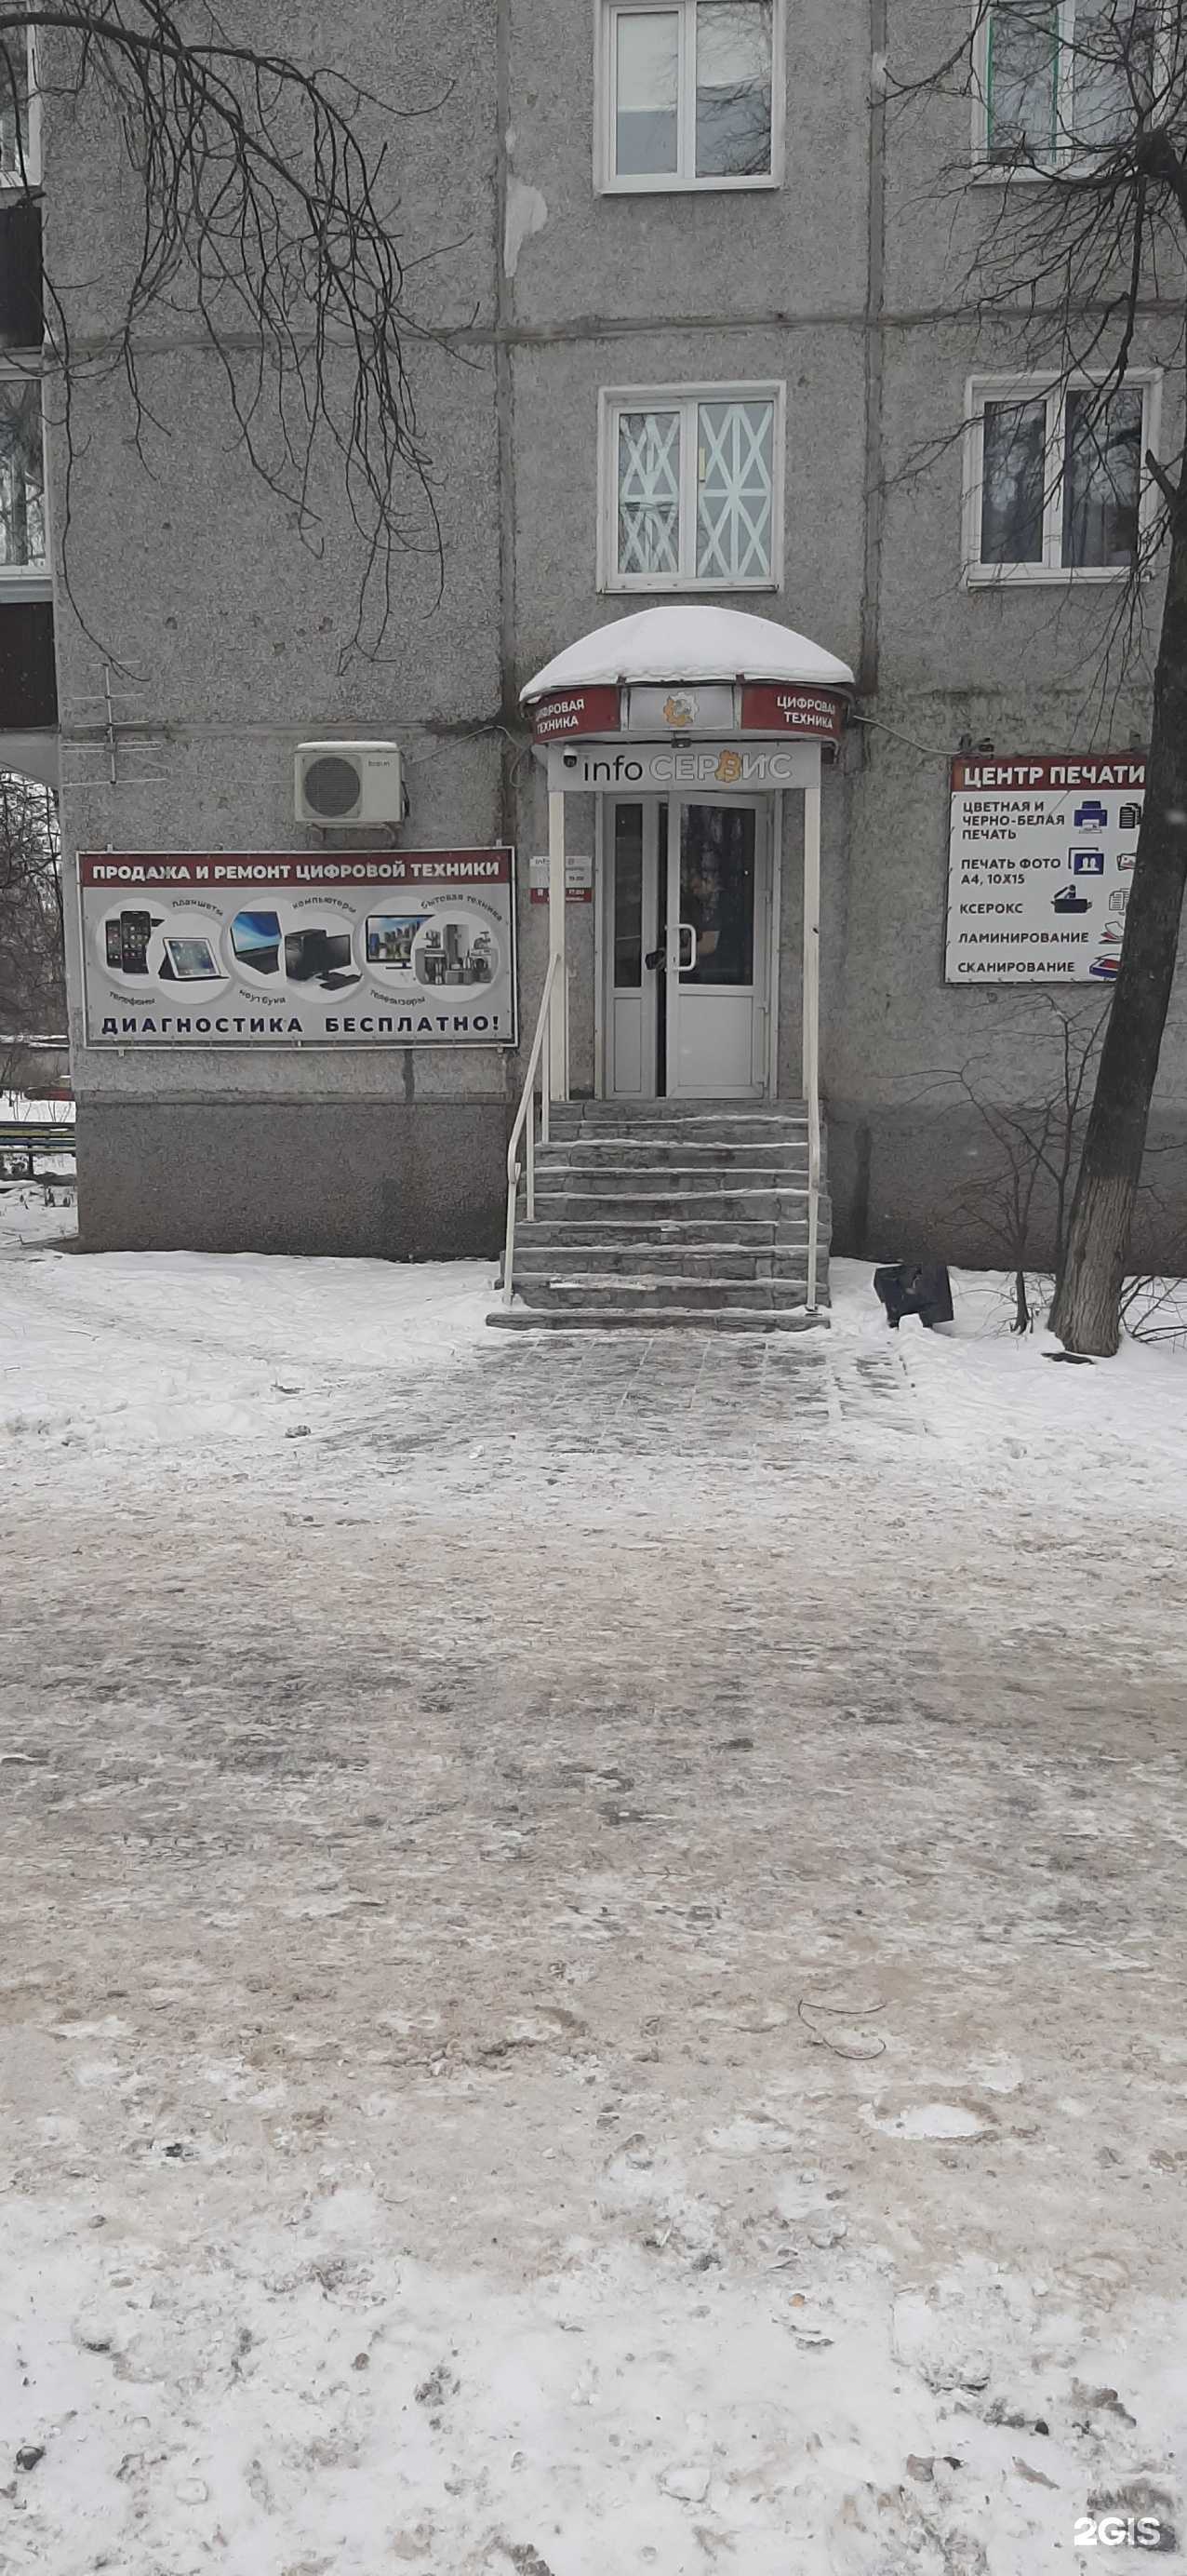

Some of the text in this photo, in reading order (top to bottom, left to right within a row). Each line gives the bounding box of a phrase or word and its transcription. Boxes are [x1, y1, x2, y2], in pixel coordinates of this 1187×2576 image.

[537, 716, 579, 734] ТЕХНИКА
[783, 711, 834, 730] ТЕХНИКА
[583, 750, 793, 783] info СЕРВИС
[964, 766, 1145, 788] ЦЕНТР ПЕЧАТИ
[963, 801, 1044, 814] ЦВЕТНАЯ И
[963, 815, 1065, 825] ЧЕРНО-БЕЛАЯ
[962, 829, 1017, 839] ПЕЧАТЬ
[93, 861, 500, 881] ПРОДАЖА И РЕМОНТ ЦИФРОВОЙ ТЕХНИКИ
[961, 858, 1060, 869] ПЕЧАТЬ ФОТО
[172, 900, 223, 916] планшеты
[292, 897, 356, 914] компьютеры
[420, 894, 502, 921] бытовая техника
[960, 904, 1023, 914] КСЕРОКС
[958, 932, 1089, 944] ЛАМИНИРОВАНИЕ
[957, 962, 1075, 973] СКАНИРОВАНИЕ
[239, 989, 286, 1006] ноутбуки
[101, 1015, 500, 1035] ДИАГНОСТИКА БЕСПЛАТНО!
